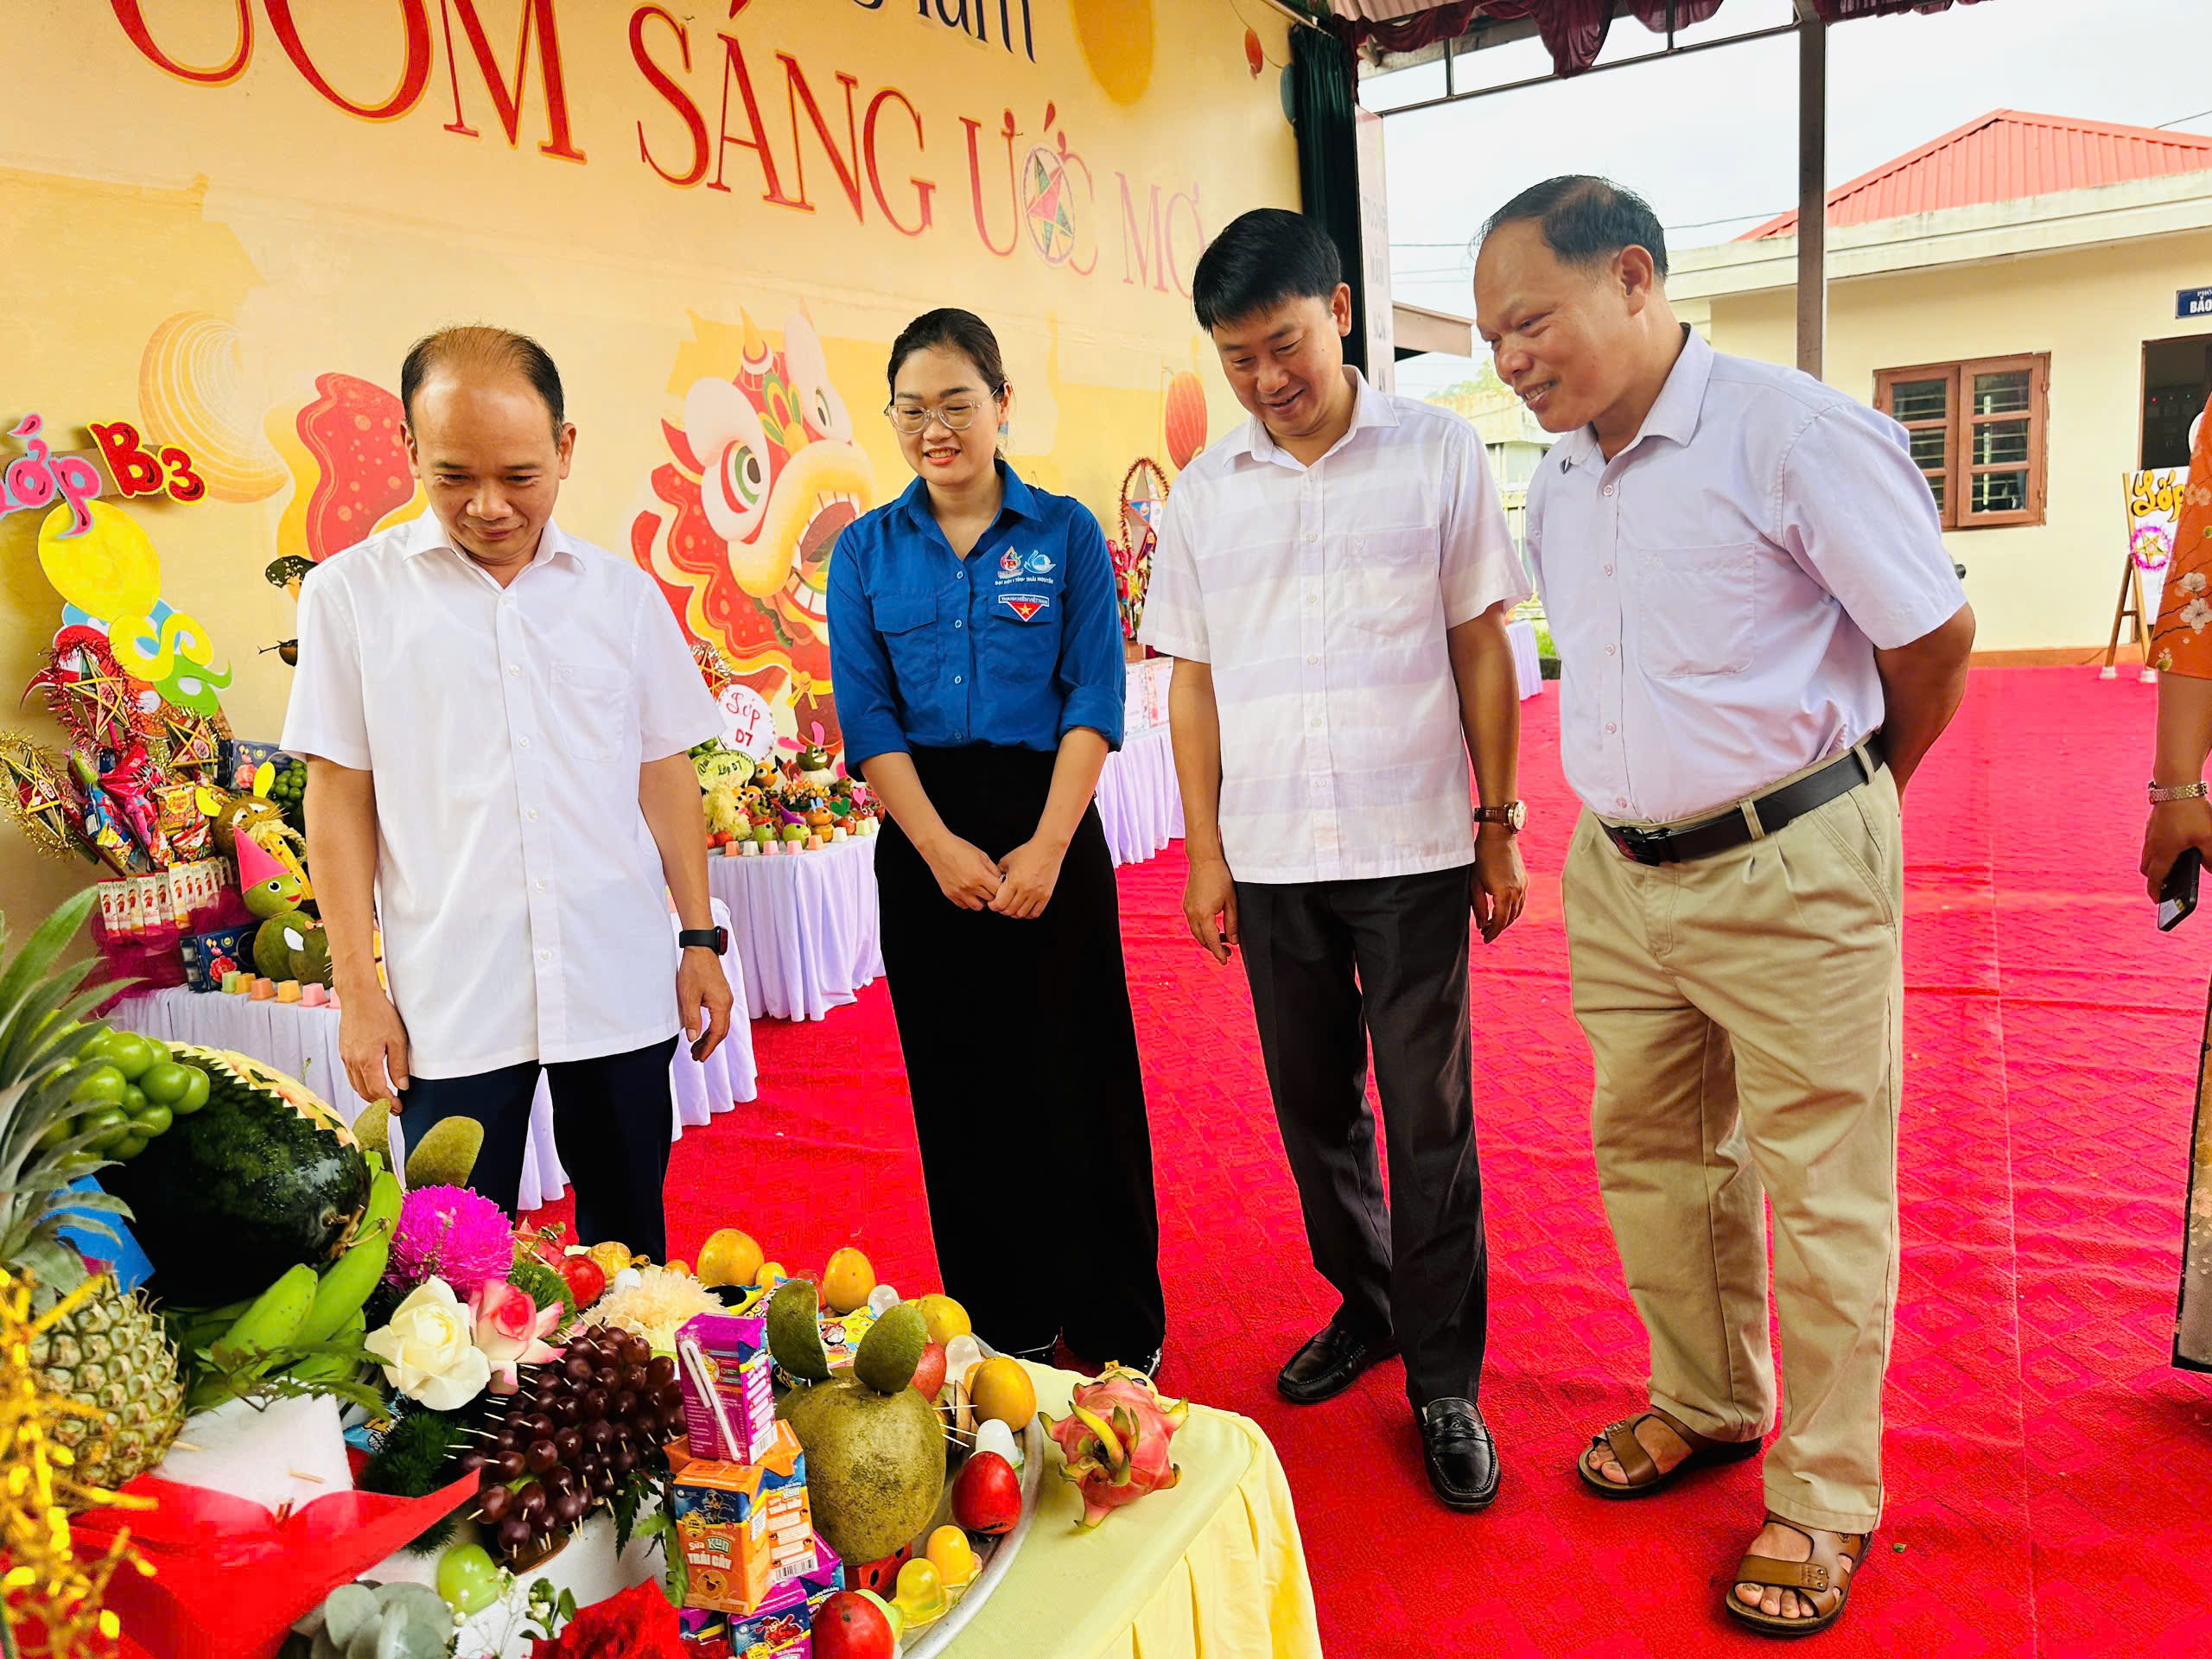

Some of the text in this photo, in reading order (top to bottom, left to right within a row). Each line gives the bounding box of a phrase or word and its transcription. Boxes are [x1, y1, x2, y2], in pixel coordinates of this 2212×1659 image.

[629, 0, 935, 238] SÁNG
[0, 413, 207, 538] ớp B3
[732, 760, 742, 771] D7
[735, 728, 753, 747] D7
